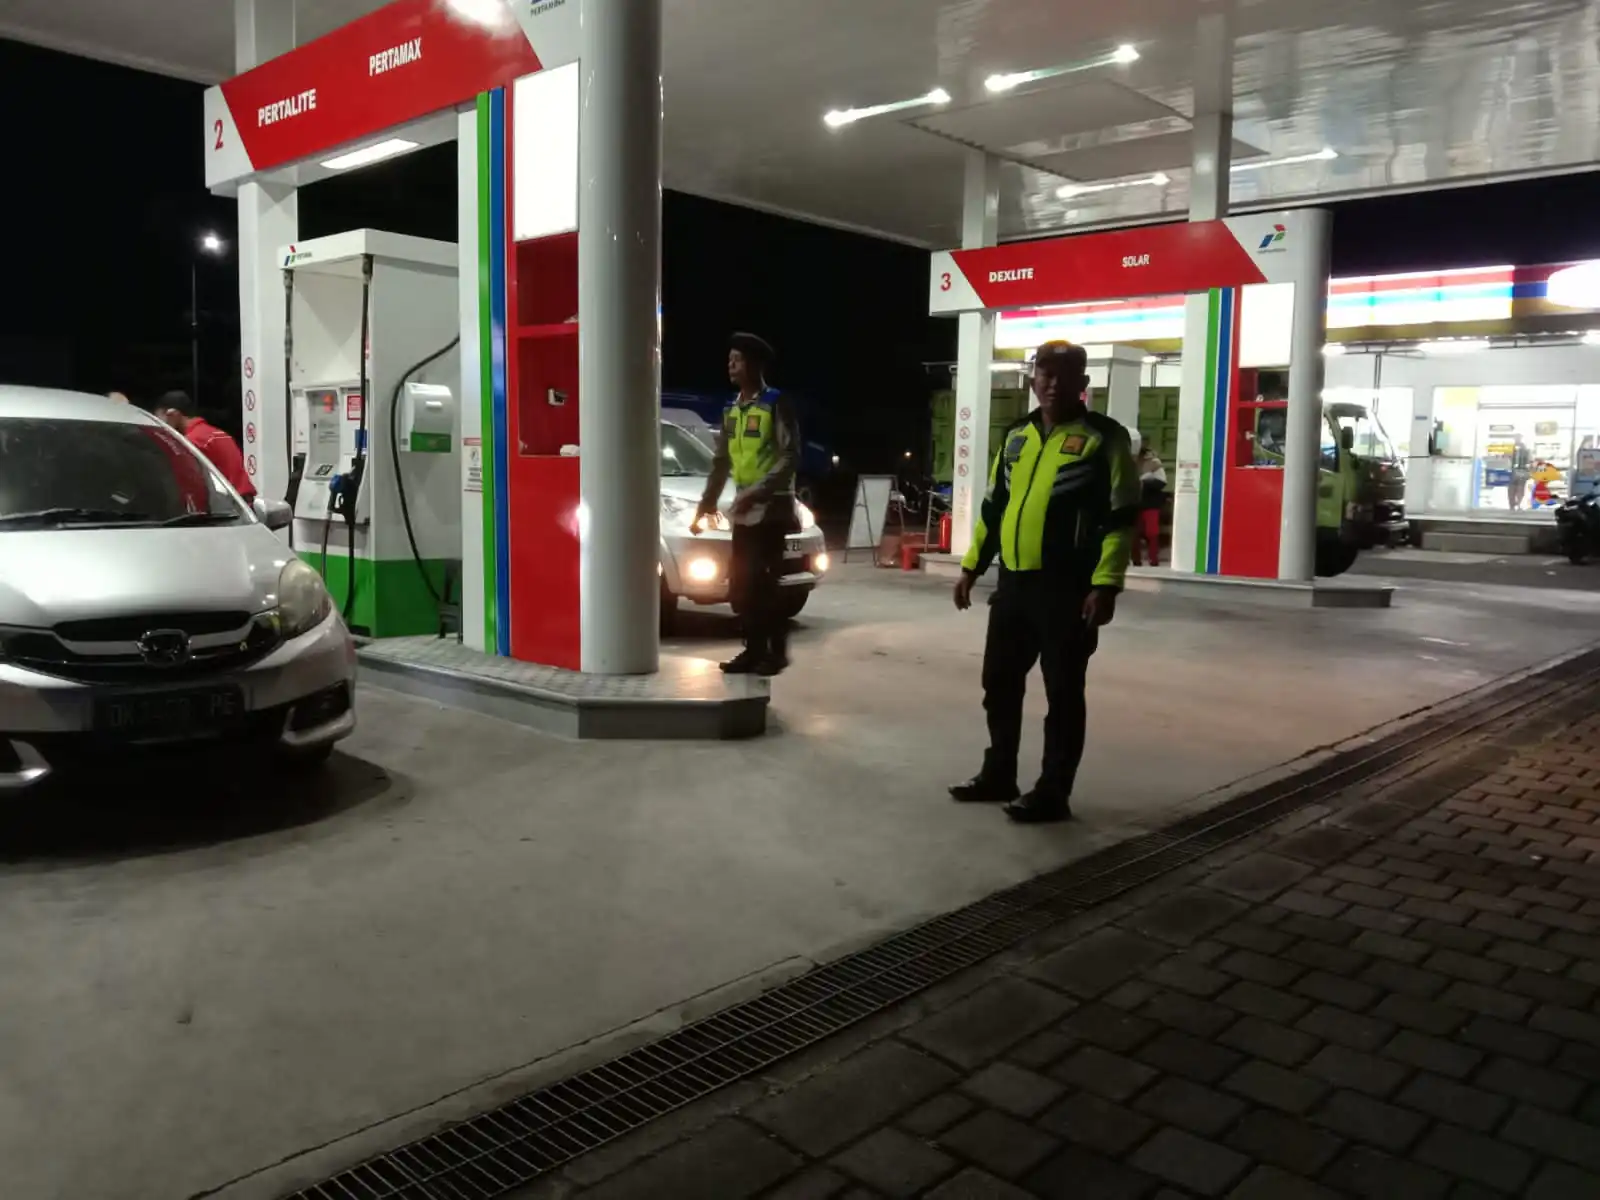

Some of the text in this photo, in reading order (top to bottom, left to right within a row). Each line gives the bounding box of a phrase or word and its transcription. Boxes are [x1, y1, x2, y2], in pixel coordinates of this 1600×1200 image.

[369, 37, 422, 76] PERTAMAX
[258, 88, 316, 127] PERTALITE
[214, 119, 224, 150] 2
[1122, 254, 1150, 267] SOLAR
[940, 272, 951, 291] 3
[988, 267, 1034, 283] DEXLITE
